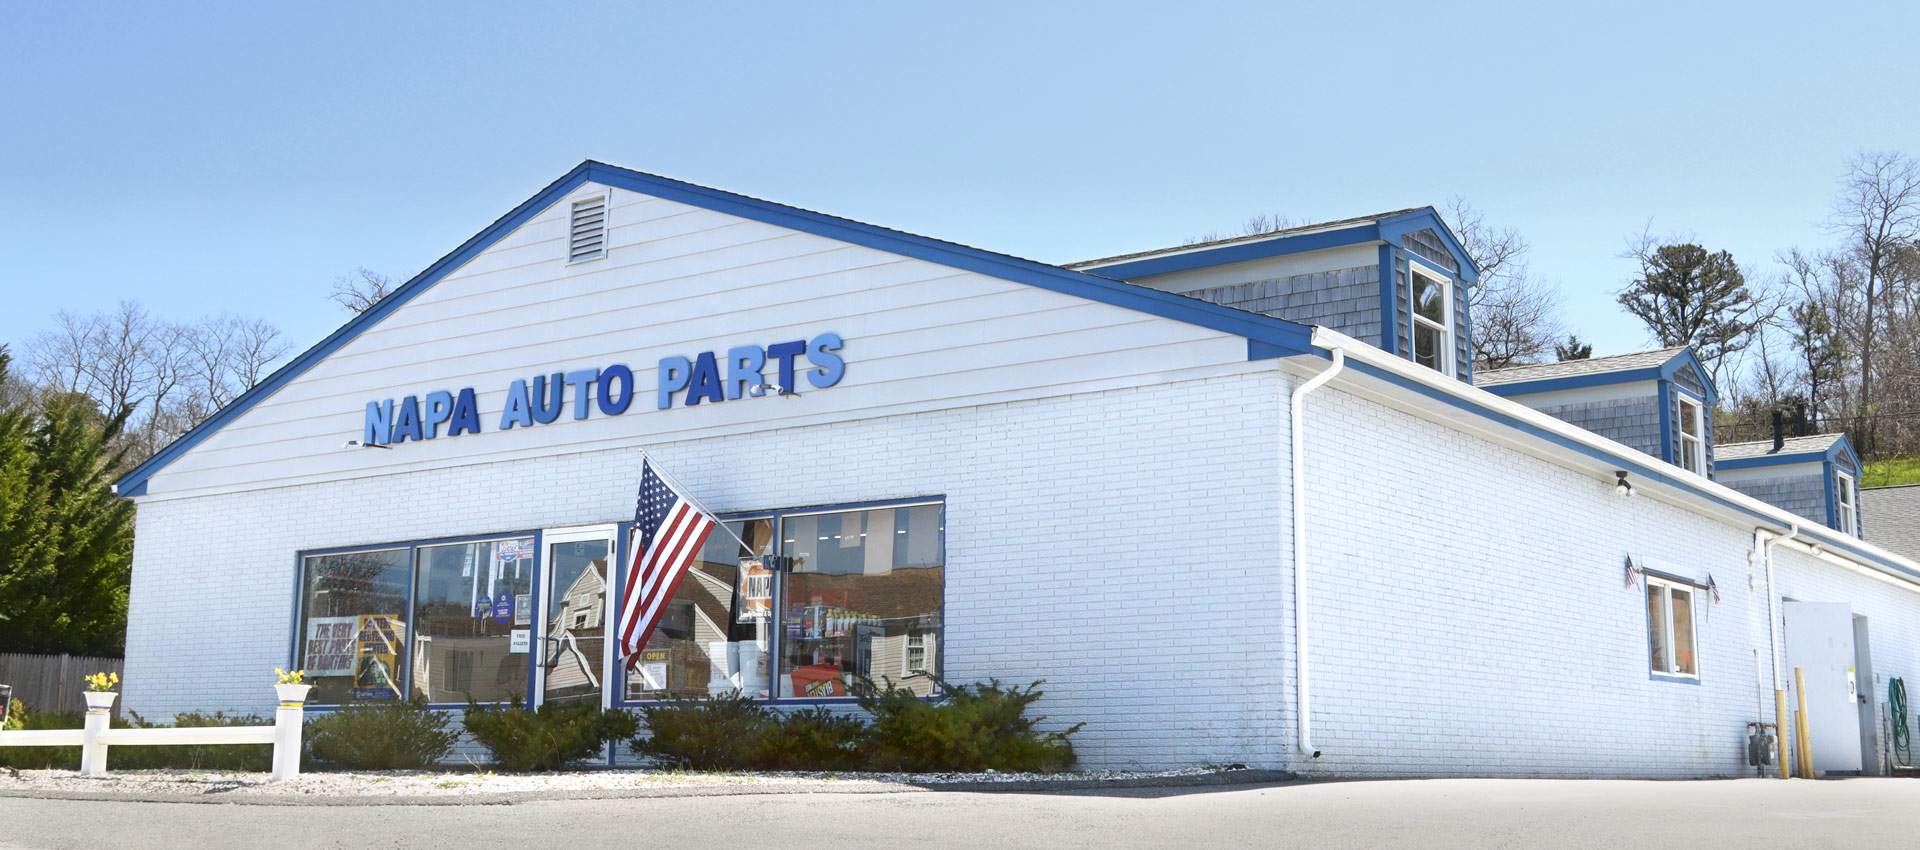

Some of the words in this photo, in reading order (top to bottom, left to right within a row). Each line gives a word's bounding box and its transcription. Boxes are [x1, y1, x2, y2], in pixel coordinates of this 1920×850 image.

[364, 387, 481, 446] NAPA
[499, 363, 634, 430] AUTO
[657, 332, 846, 410] PARTS
[748, 576, 772, 597] NAP
[315, 623, 331, 639] THE
[332, 622, 354, 639] VERY
[308, 639, 329, 655] BEST
[307, 655, 317, 671] OF
[646, 651, 666, 660] OPEN
